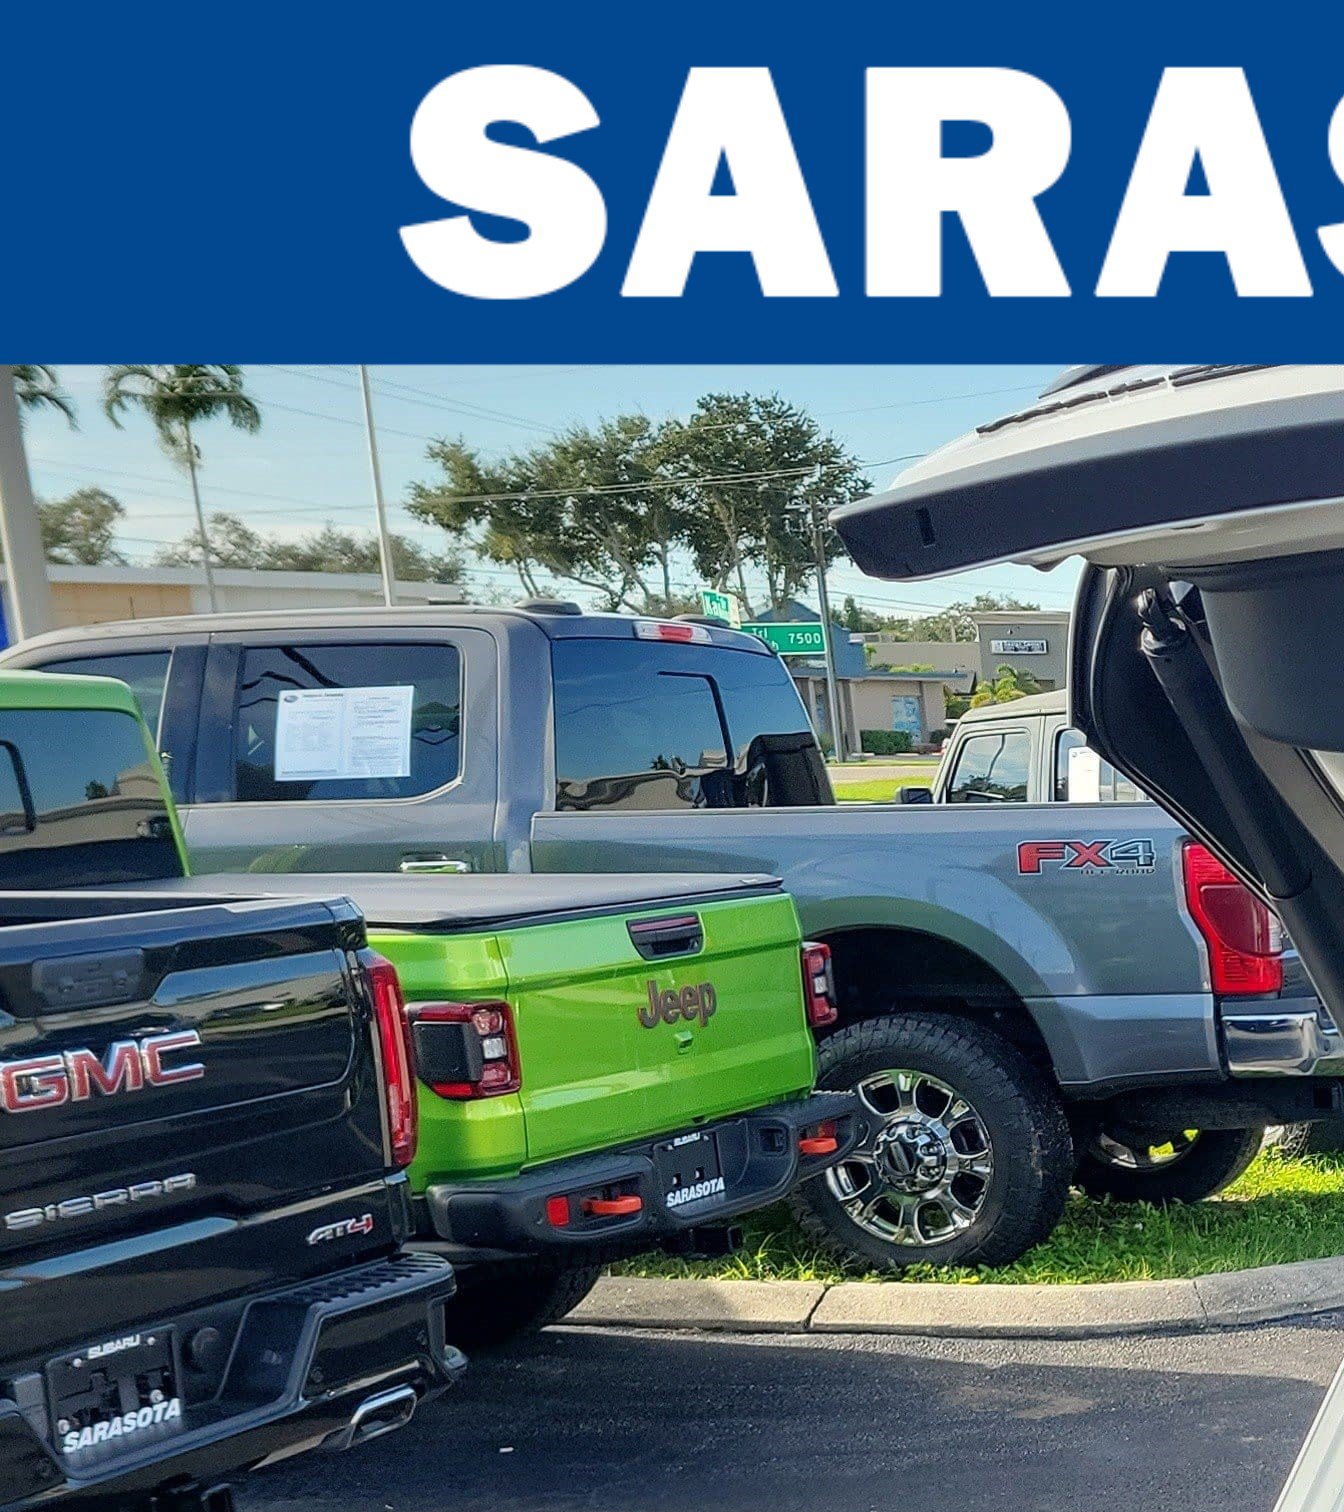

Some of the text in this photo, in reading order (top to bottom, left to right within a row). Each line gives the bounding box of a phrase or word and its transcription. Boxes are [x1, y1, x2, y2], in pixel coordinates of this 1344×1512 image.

[788, 632, 821, 645] 7500
[1017, 838, 1157, 876] FX4
[638, 979, 717, 1029] Jeep
[0, 1029, 207, 1114] GMC
[4, 1172, 197, 1230] SIERRA
[666, 1176, 726, 1208] SARASOTA
[307, 1213, 374, 1245] AT4
[87, 1334, 141, 1360] SUBARU
[62, 1397, 181, 1454] SARASOTA
